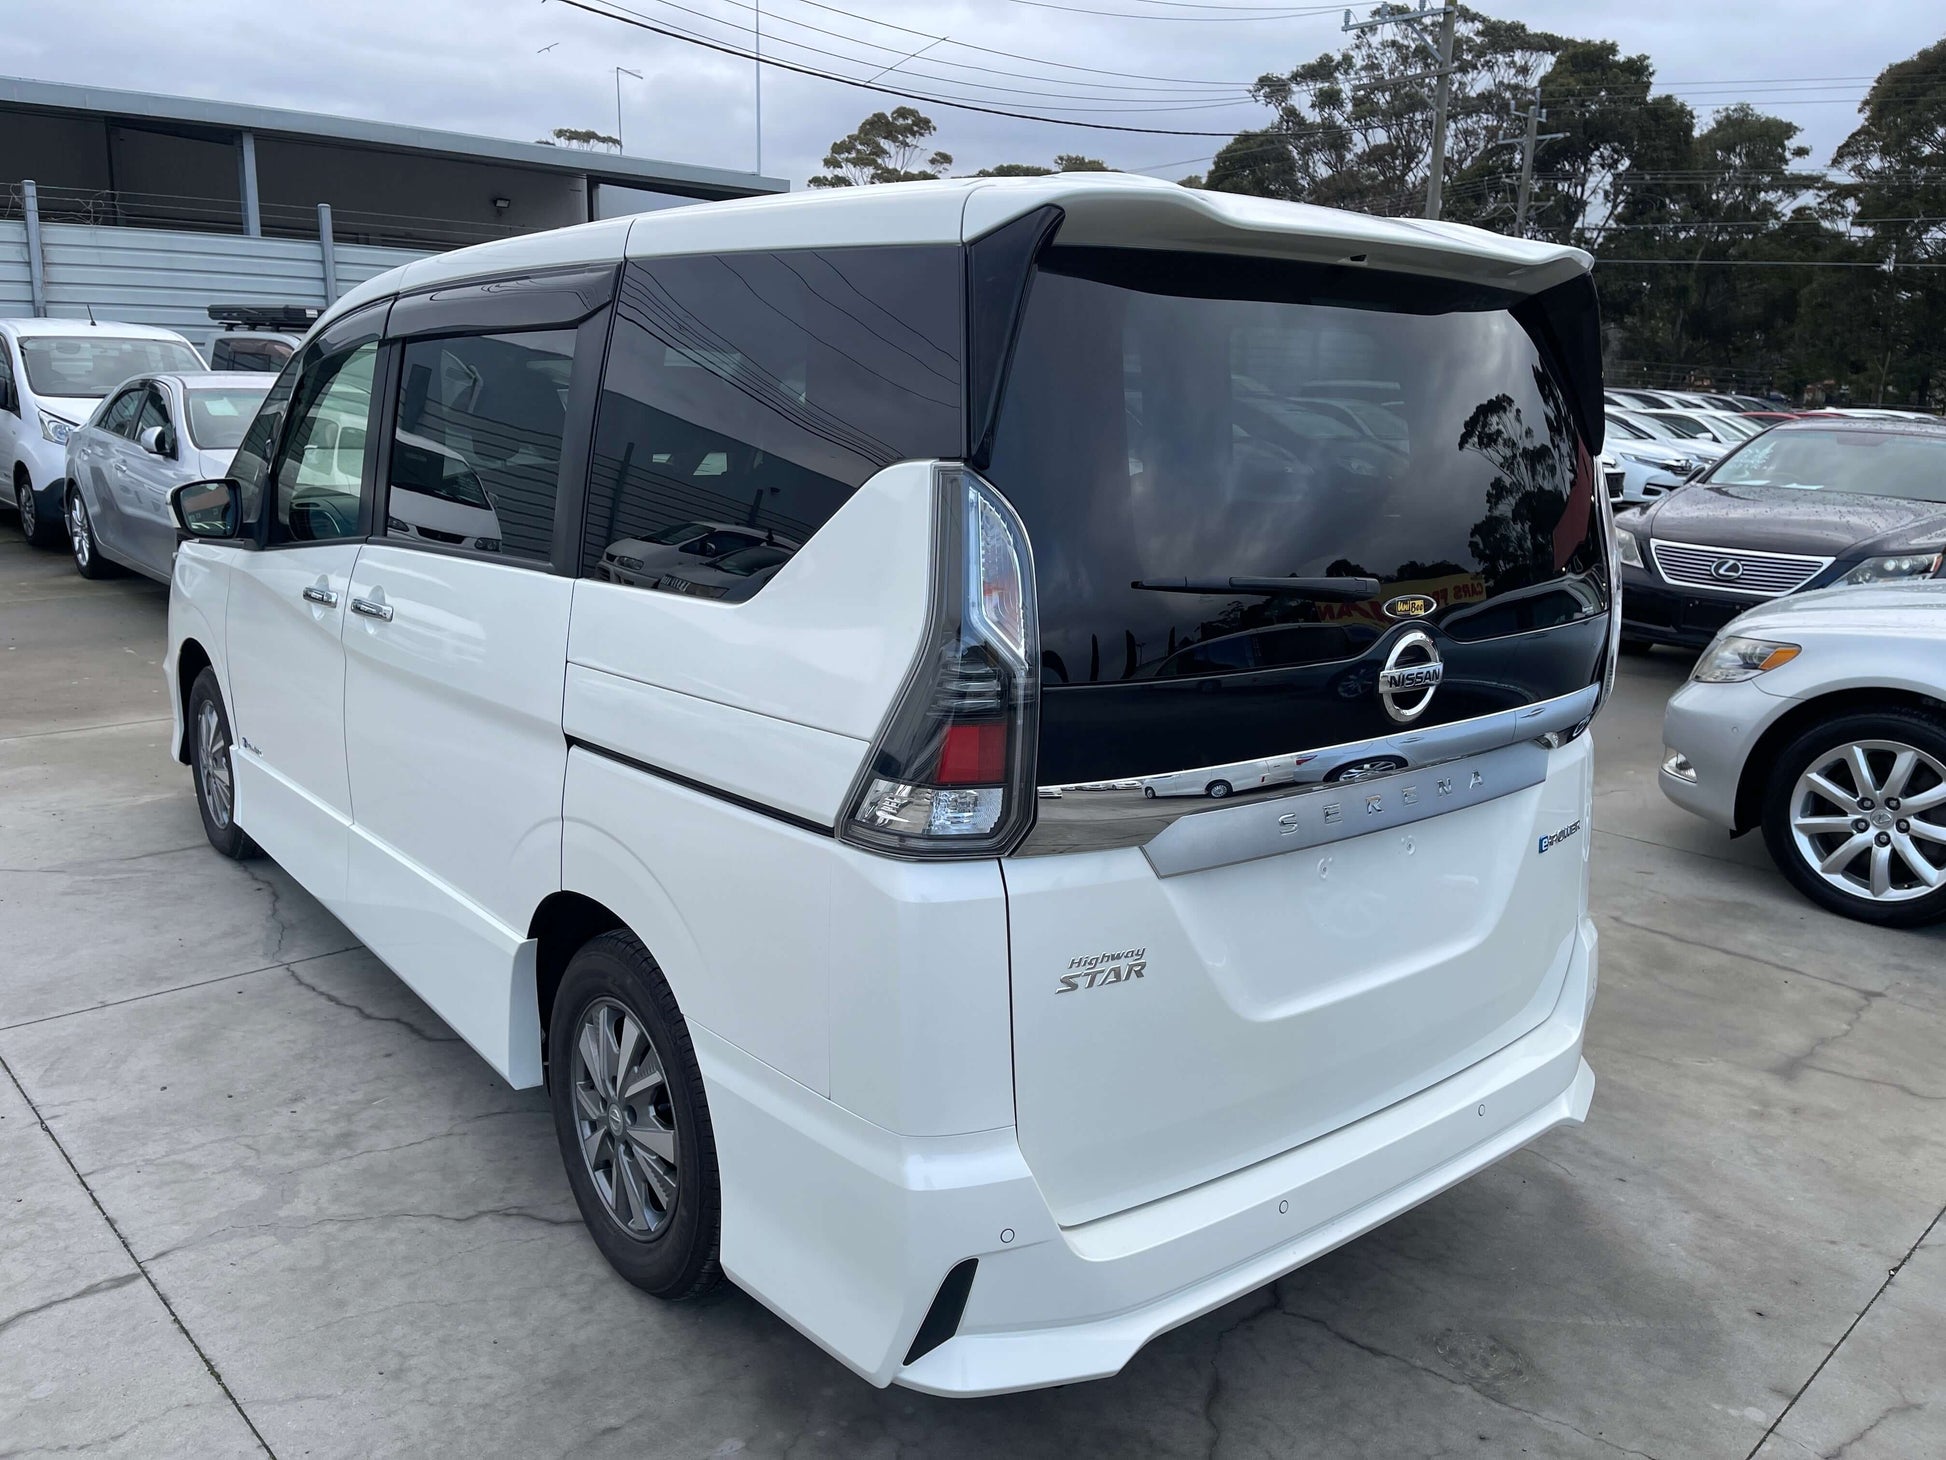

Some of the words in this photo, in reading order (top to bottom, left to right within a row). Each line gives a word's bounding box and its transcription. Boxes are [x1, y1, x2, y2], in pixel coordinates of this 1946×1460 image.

[1388, 668, 1441, 688] NISSAN
[1278, 768, 1485, 837] SERENA
[1067, 946, 1147, 971] Highway
[1054, 959, 1147, 995] STAR
